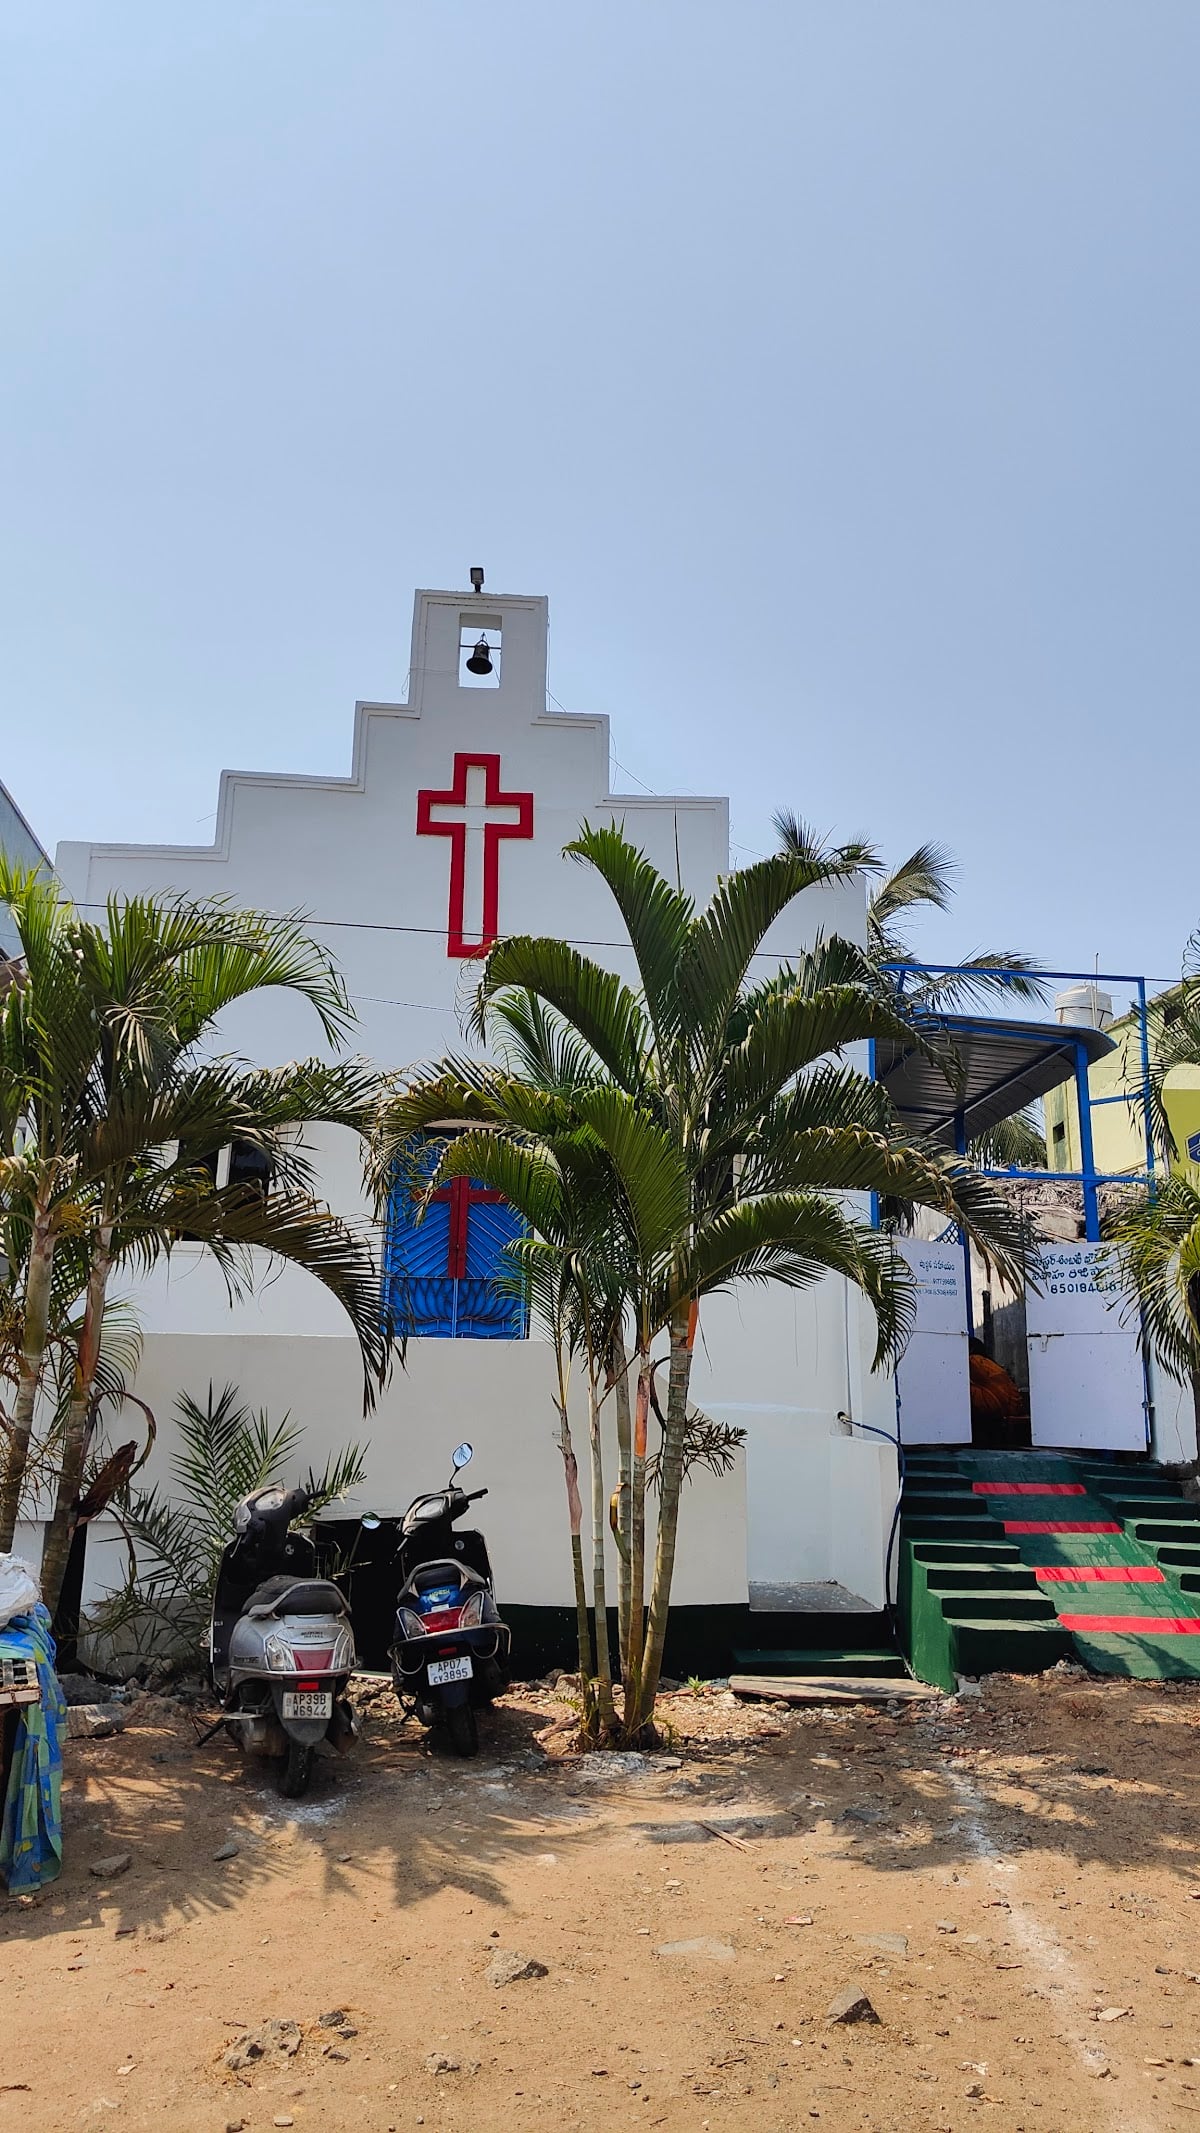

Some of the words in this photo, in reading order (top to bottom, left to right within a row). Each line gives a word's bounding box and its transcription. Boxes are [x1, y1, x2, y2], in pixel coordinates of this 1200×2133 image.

[437, 1658, 461, 1672] AP07
[293, 1694, 327, 1705] AP39B
[293, 1705, 327, 1717] W6944
